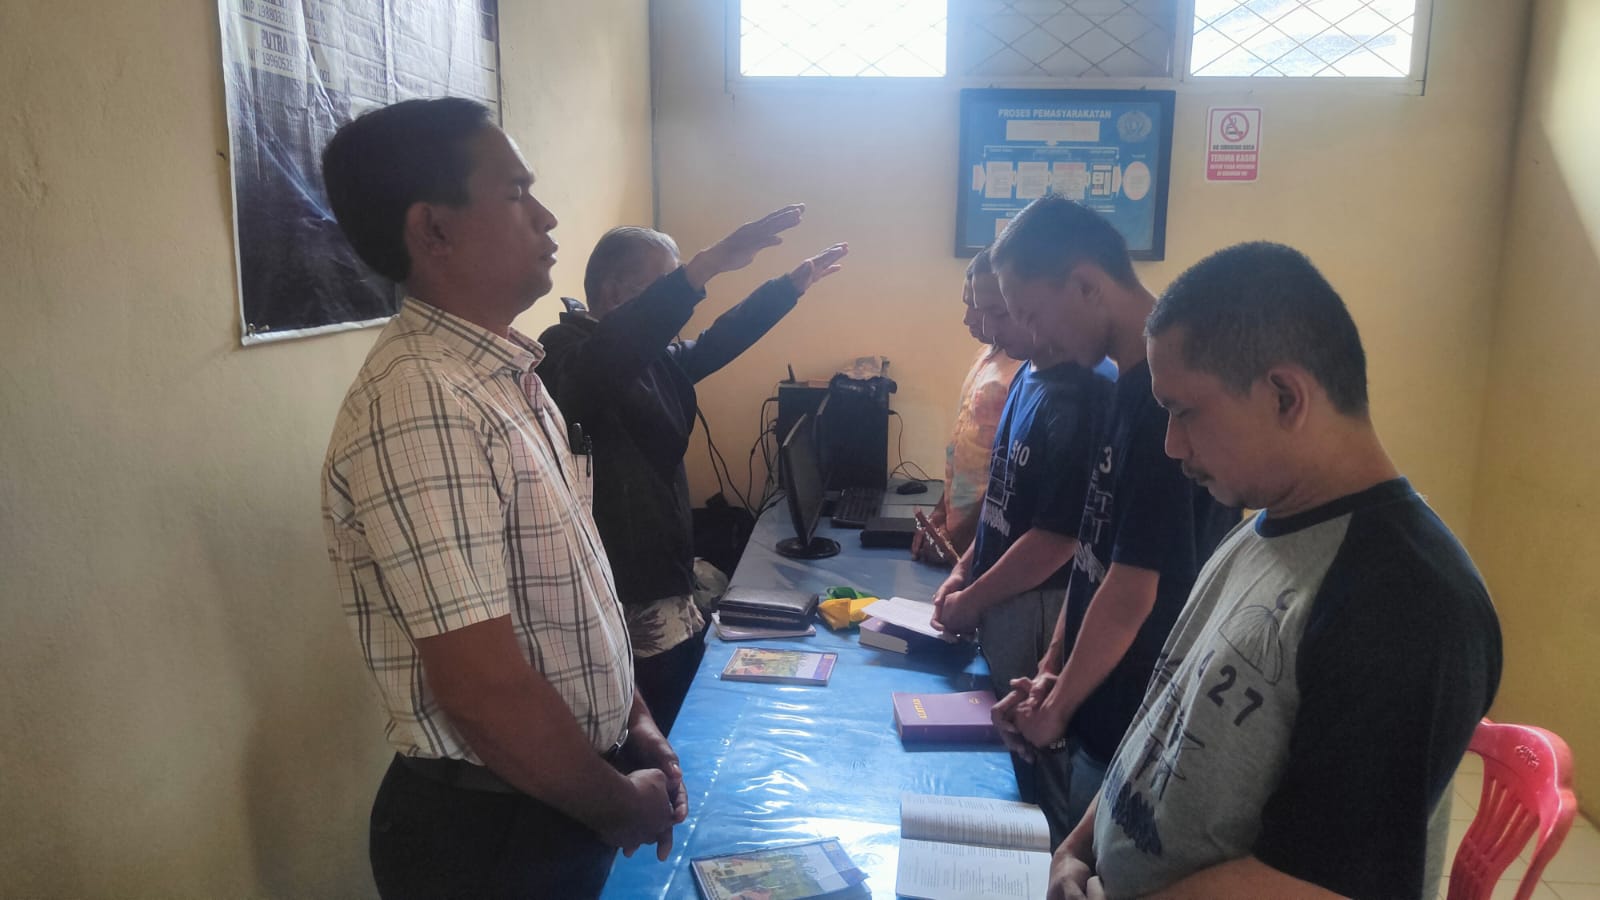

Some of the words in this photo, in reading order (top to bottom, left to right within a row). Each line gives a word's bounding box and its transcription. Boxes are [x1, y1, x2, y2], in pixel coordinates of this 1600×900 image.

[261, 29, 288, 54] PUTRA
[998, 109, 1031, 118] PROSES
[1033, 109, 1112, 119] PEMASYARAKATAN
